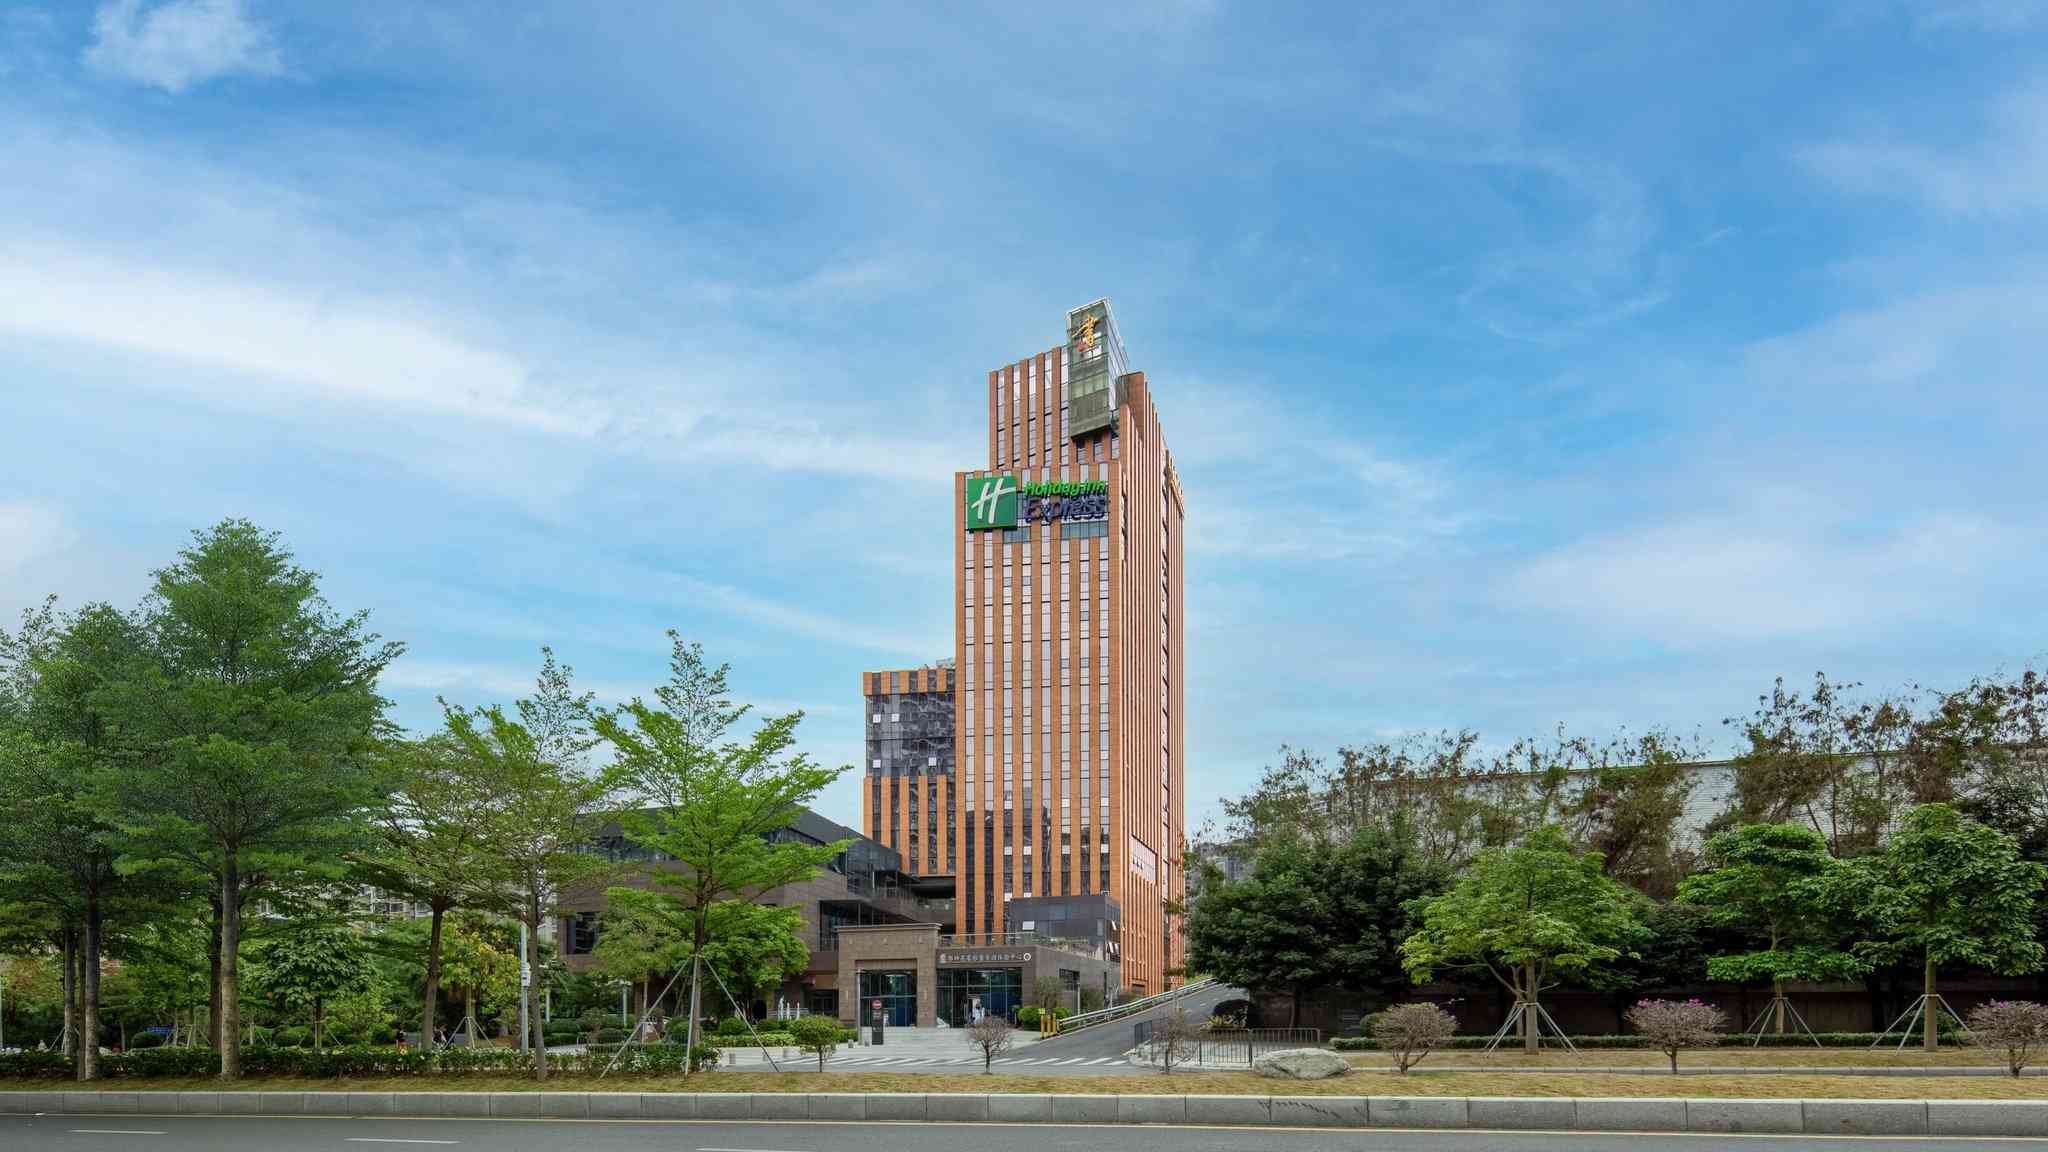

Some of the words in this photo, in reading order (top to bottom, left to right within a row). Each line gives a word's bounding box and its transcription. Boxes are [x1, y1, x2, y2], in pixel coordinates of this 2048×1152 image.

[1023, 481, 1079, 497] Holiday
[1081, 480, 1106, 495] Inn
[1024, 495, 1106, 524] Express
